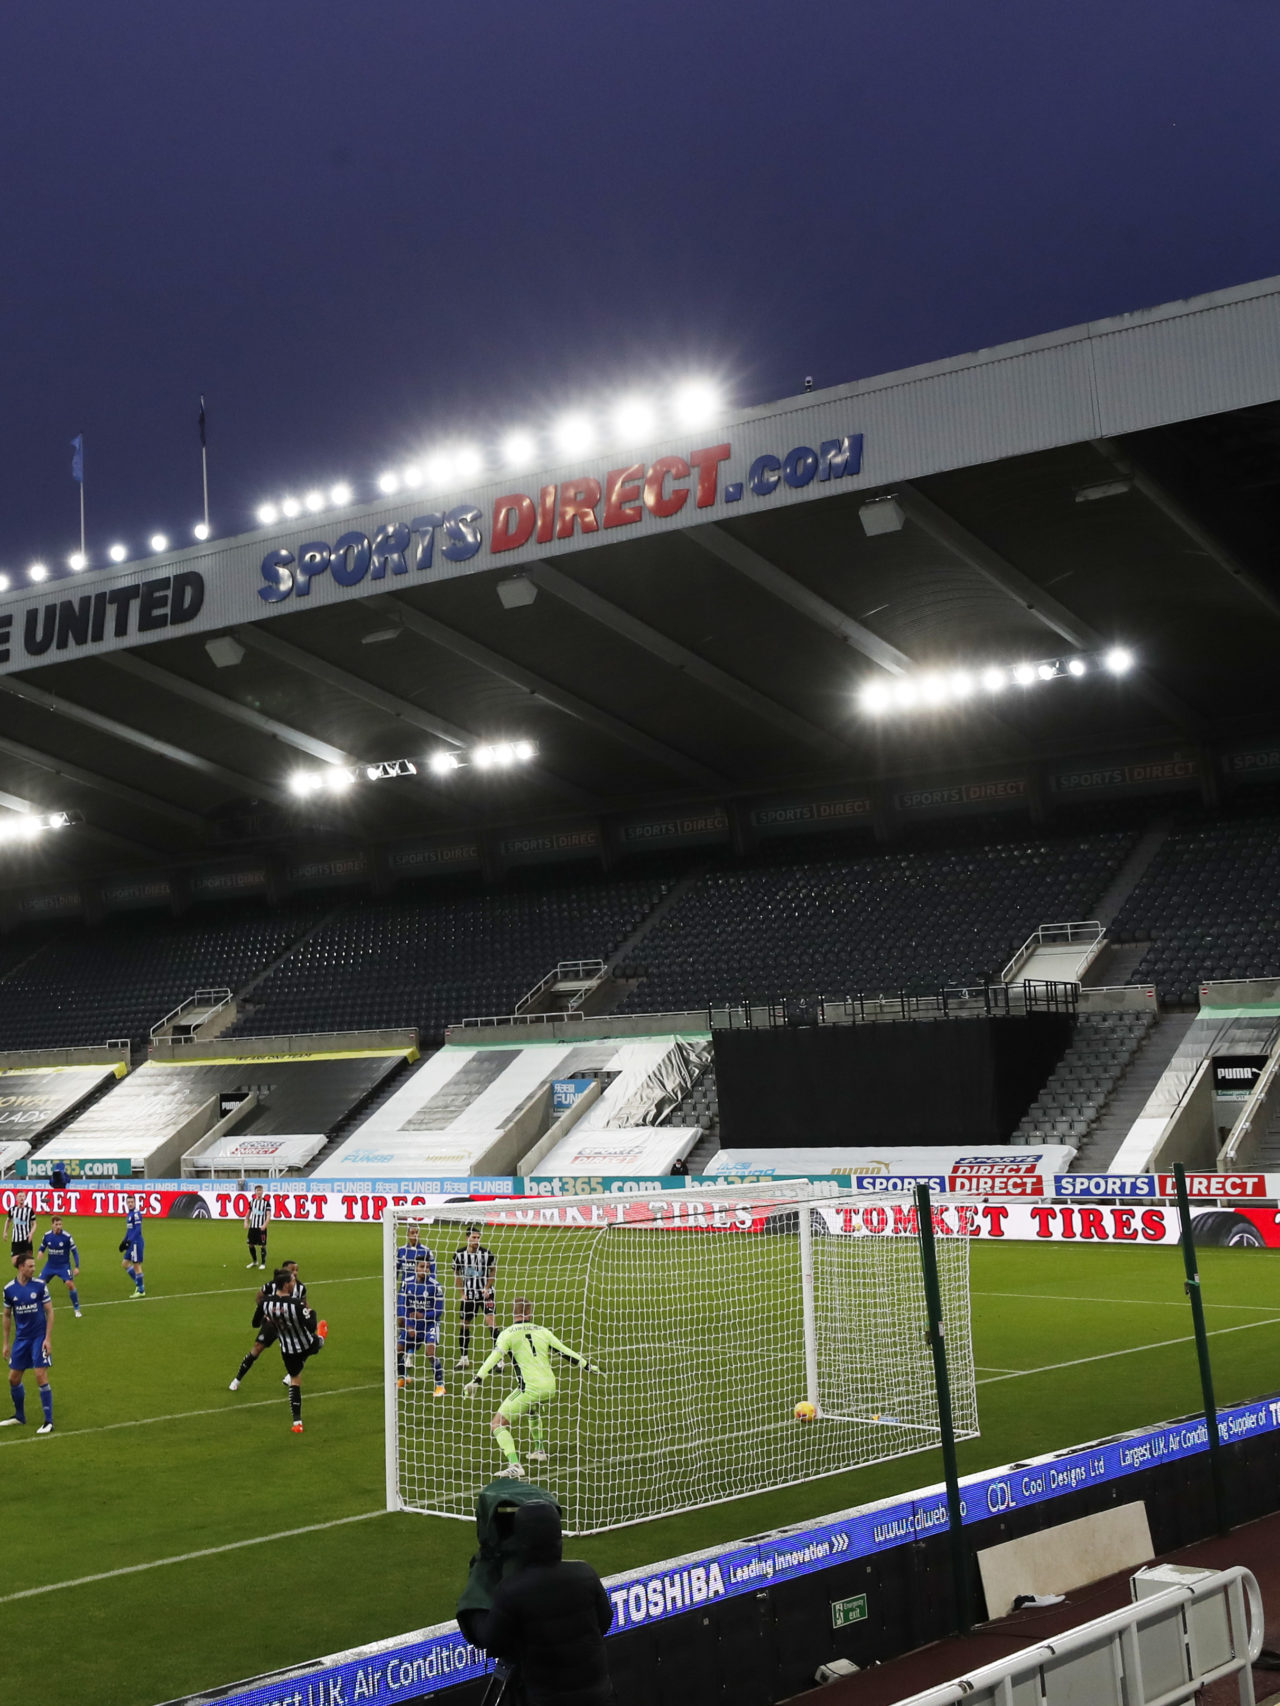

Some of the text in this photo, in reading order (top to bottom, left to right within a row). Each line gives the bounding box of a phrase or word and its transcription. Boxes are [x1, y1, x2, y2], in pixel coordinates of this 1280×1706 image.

[24, 571, 205, 656] UNITED
[1233, 752, 1280, 769] SPOR
[683, 816, 728, 832] DIREC
[559, 832, 596, 847] DIREC
[443, 847, 478, 861] DIREC
[1217, 1067, 1253, 1079] PUMA
[955, 1165, 1033, 1175] DIRECT
[334, 1182, 373, 1193] FUN88
[401, 1182, 441, 1193] FUN88
[471, 1181, 513, 1193] FUN88
[524, 1177, 662, 1197] bet365.com
[862, 1177, 1037, 1194] SPORTS DIRECT
[1060, 1177, 1150, 1194] SPORTS
[92, 1192, 162, 1215] TIRES
[217, 1194, 328, 1219] TOKET
[649, 1200, 754, 1229] TIRES
[835, 1205, 1167, 1241] TOMKET TIRES
[525, 1333, 537, 1357] 1
[1120, 1442, 1150, 1467] Largest
[1169, 1433, 1181, 1450] Air
[1181, 1421, 1229, 1448] Conditing
[1228, 1412, 1257, 1436] Supplier
[1258, 1406, 1267, 1426] of
[873, 1456, 1105, 1543] www.cdlweb.o CDL Cool Designs Ltd
[610, 1540, 830, 1627] TOSHIBA Leading Innovation
[353, 1670, 382, 1700] Air
[386, 1642, 488, 1691] Conditioni
